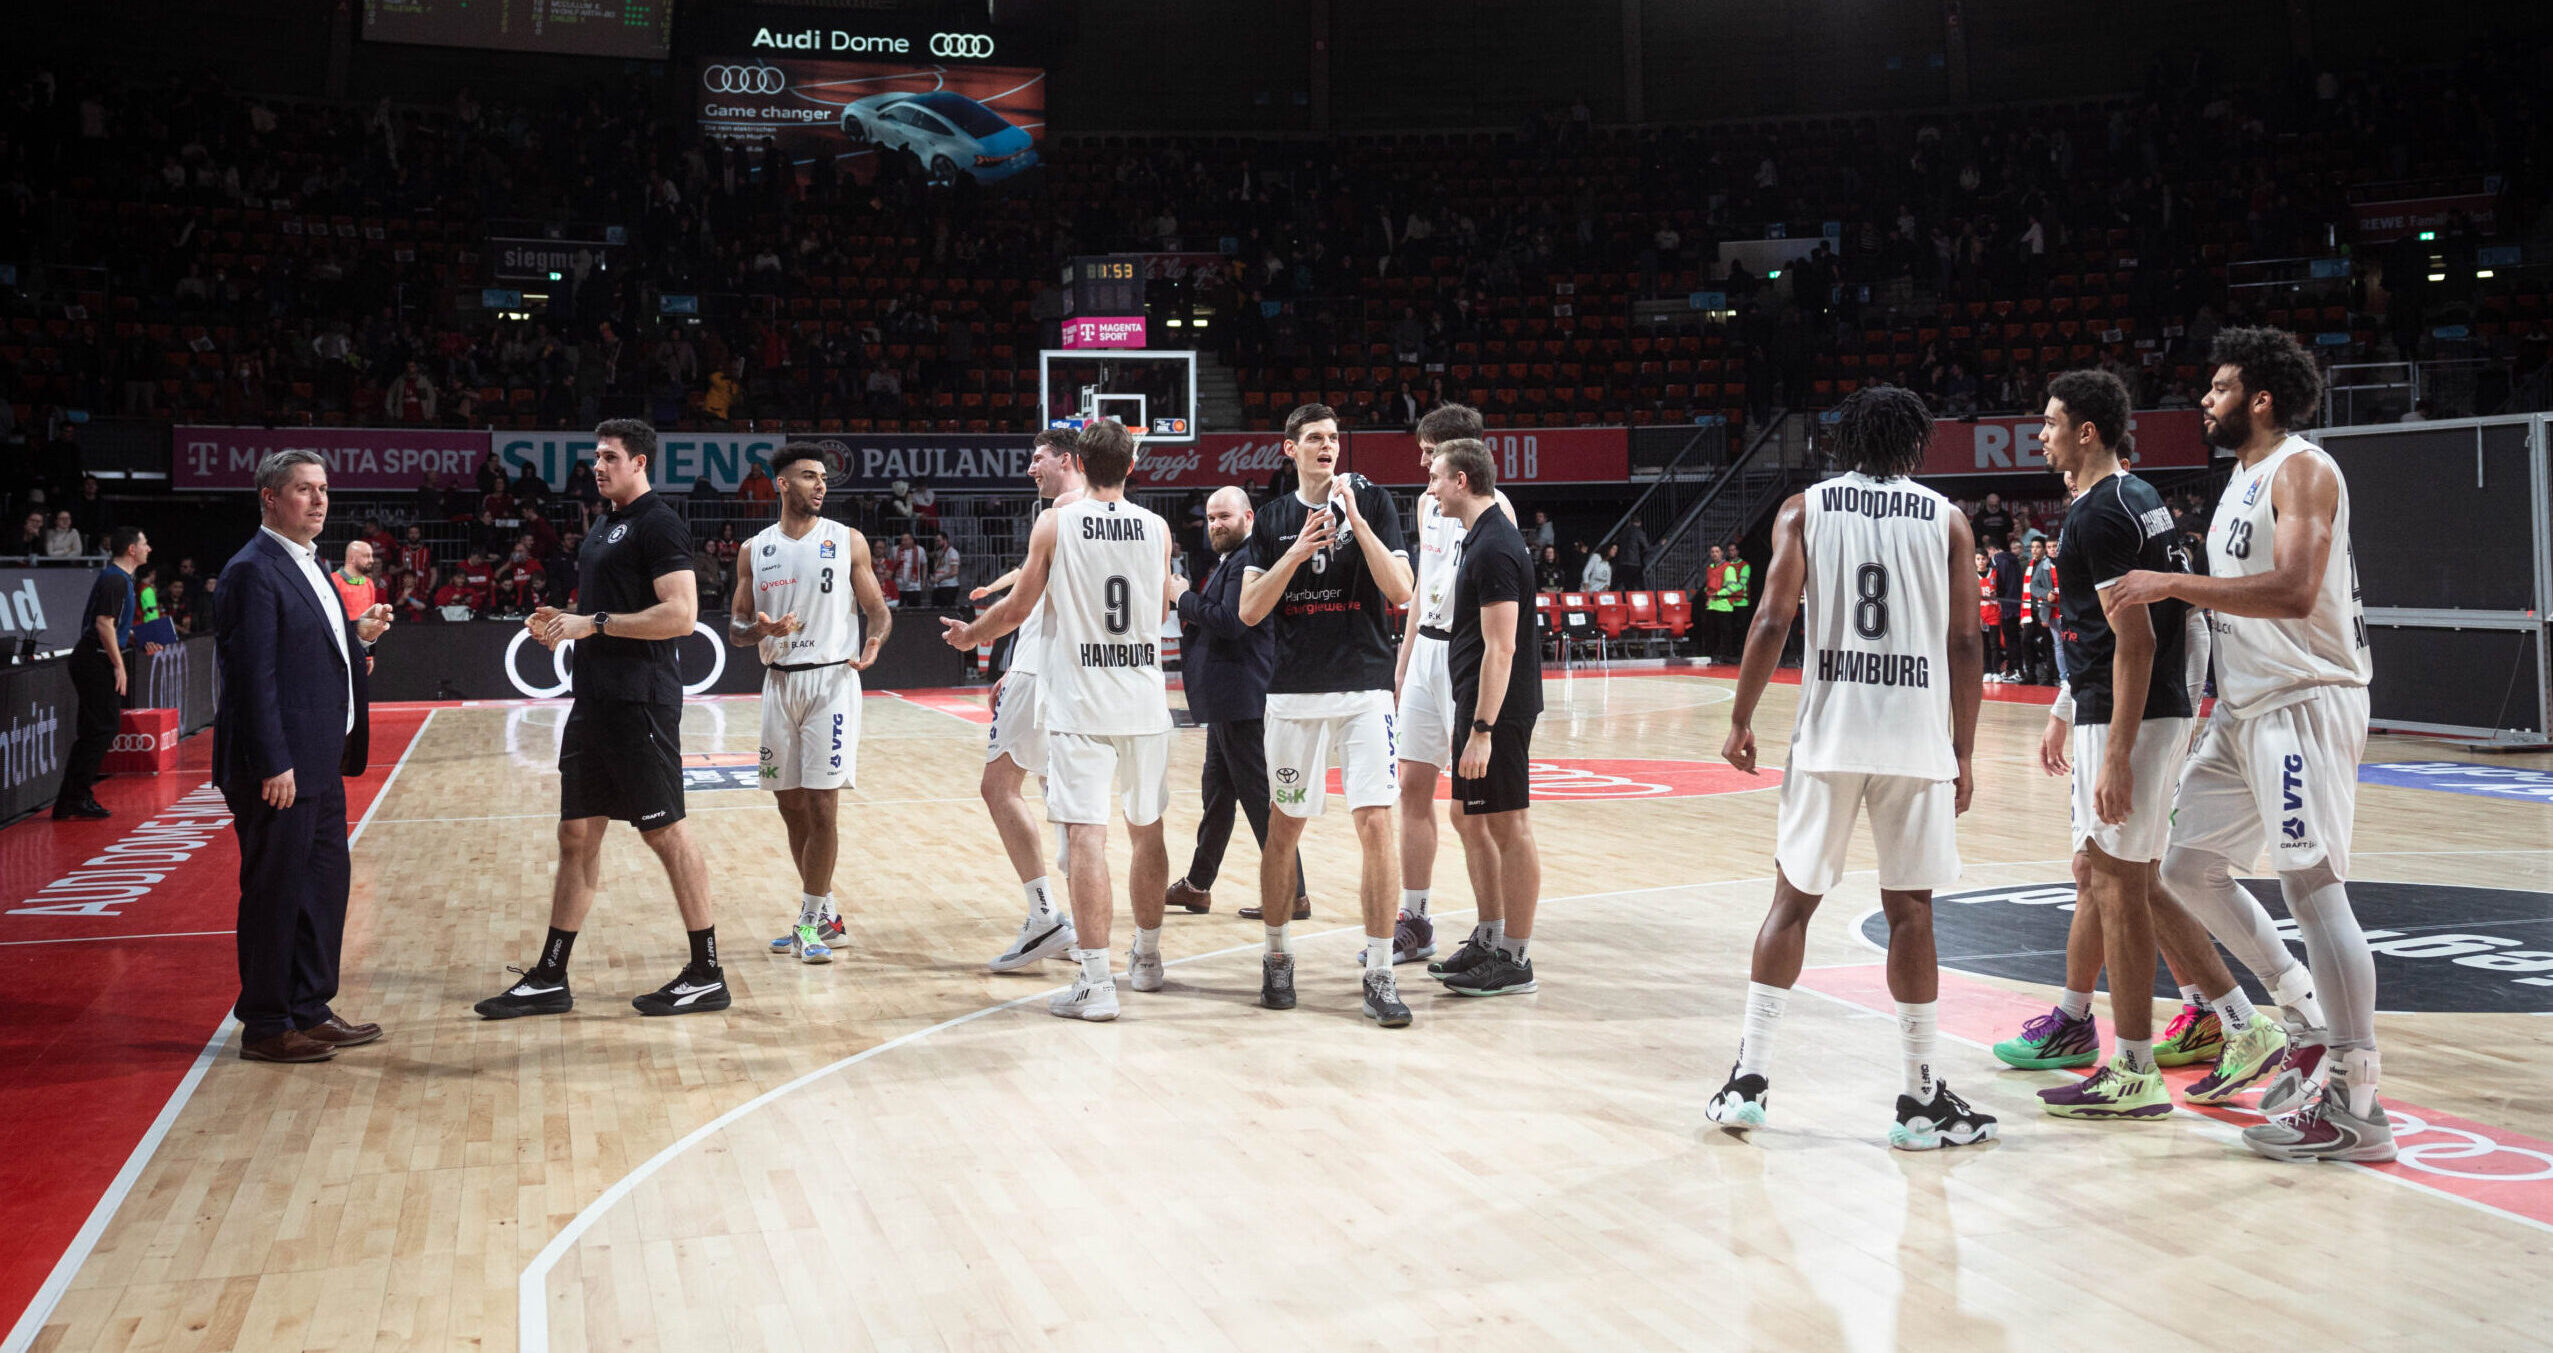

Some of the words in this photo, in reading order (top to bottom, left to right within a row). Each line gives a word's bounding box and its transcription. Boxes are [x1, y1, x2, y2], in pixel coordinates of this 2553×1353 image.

[752, 28, 821, 50] Audi
[831, 31, 910, 53] Dome
[705, 103, 757, 118] Game
[761, 105, 831, 122] changer
[1099, 323, 1143, 333] MAGENTA
[1099, 333, 1129, 342] SPORT
[383, 447, 478, 475] SPORT
[503, 440, 775, 485] SIEENS
[863, 447, 1036, 479] PAULANE
[1821, 486, 1936, 522] WOODARD
[1082, 516, 1145, 541] SAMAR
[2226, 517, 2254, 561] 23
[769, 578, 797, 588] VEOLIA
[820, 566, 834, 594] 3
[1105, 575, 1130, 636] 9
[1854, 562, 1889, 641] 8
[1080, 643, 1155, 668] HAMBURG
[1818, 649, 1930, 689] HAMBURG
[831, 713, 844, 751] VTG
[2283, 754, 2304, 811] VTG
[641, 811, 660, 821] CRAFT
[4, 867, 178, 916] AUDI
